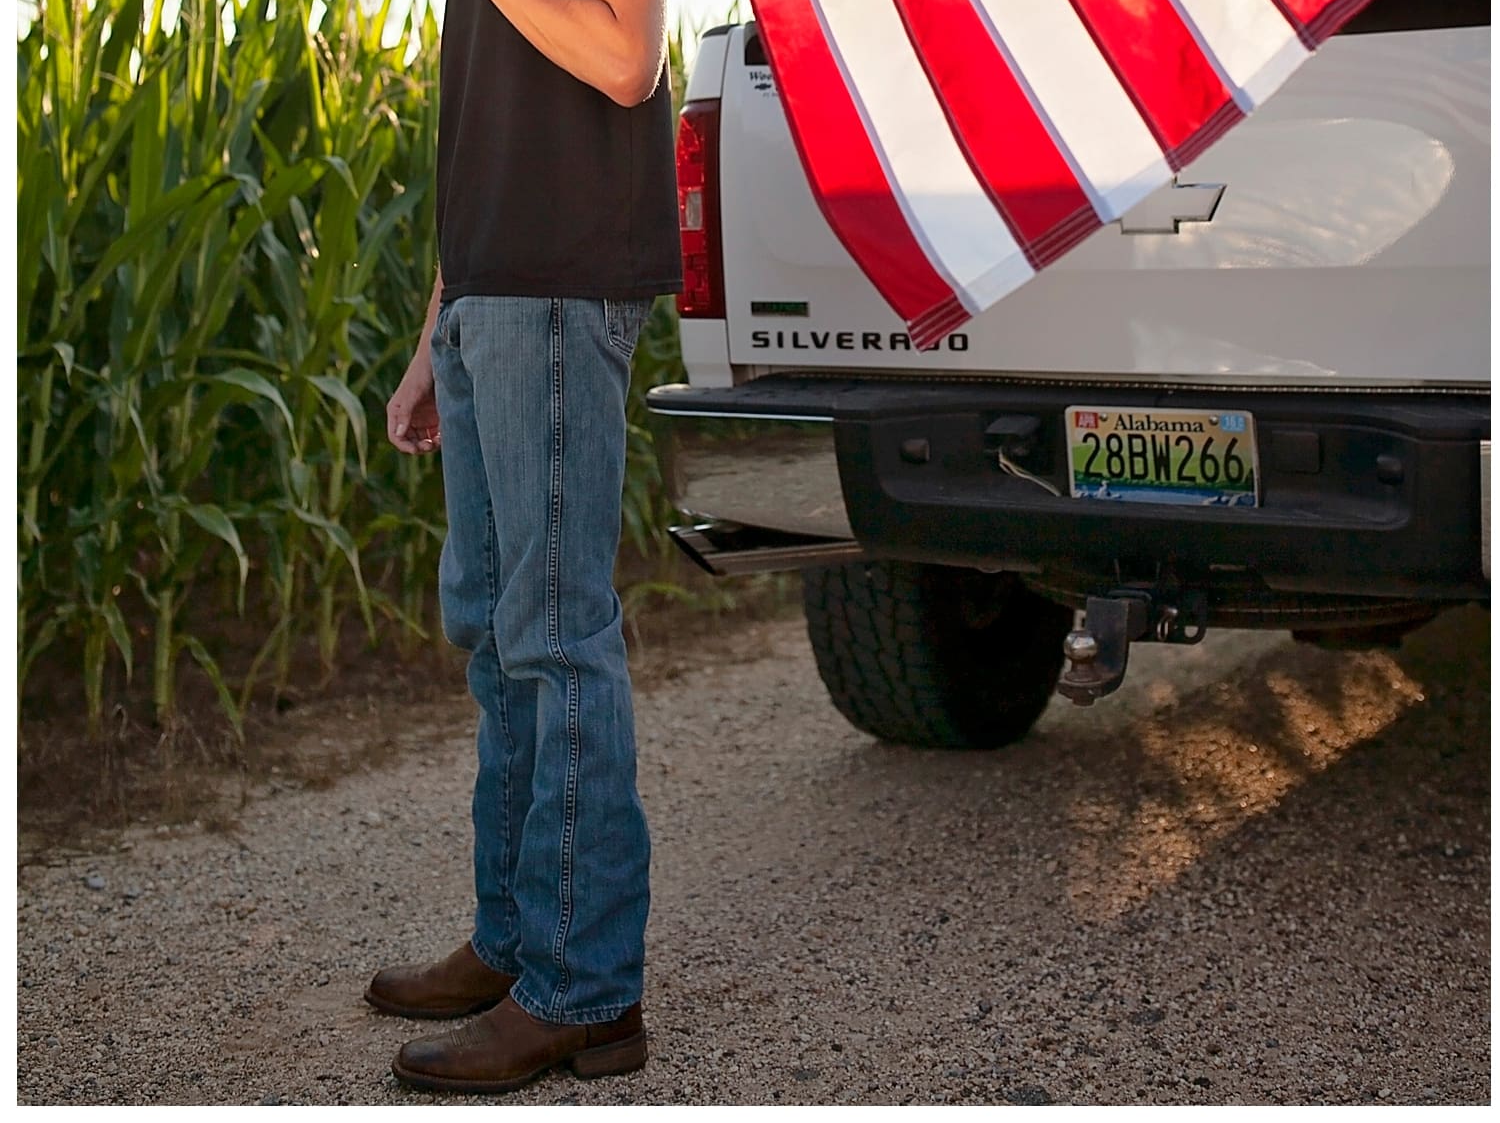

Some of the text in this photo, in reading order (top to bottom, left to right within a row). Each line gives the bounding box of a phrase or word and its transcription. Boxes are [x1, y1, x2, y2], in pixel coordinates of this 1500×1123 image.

[1078, 414, 1096, 427] APR
[1114, 414, 1205, 433] Alabama
[1082, 432, 1244, 483] 28BW266
